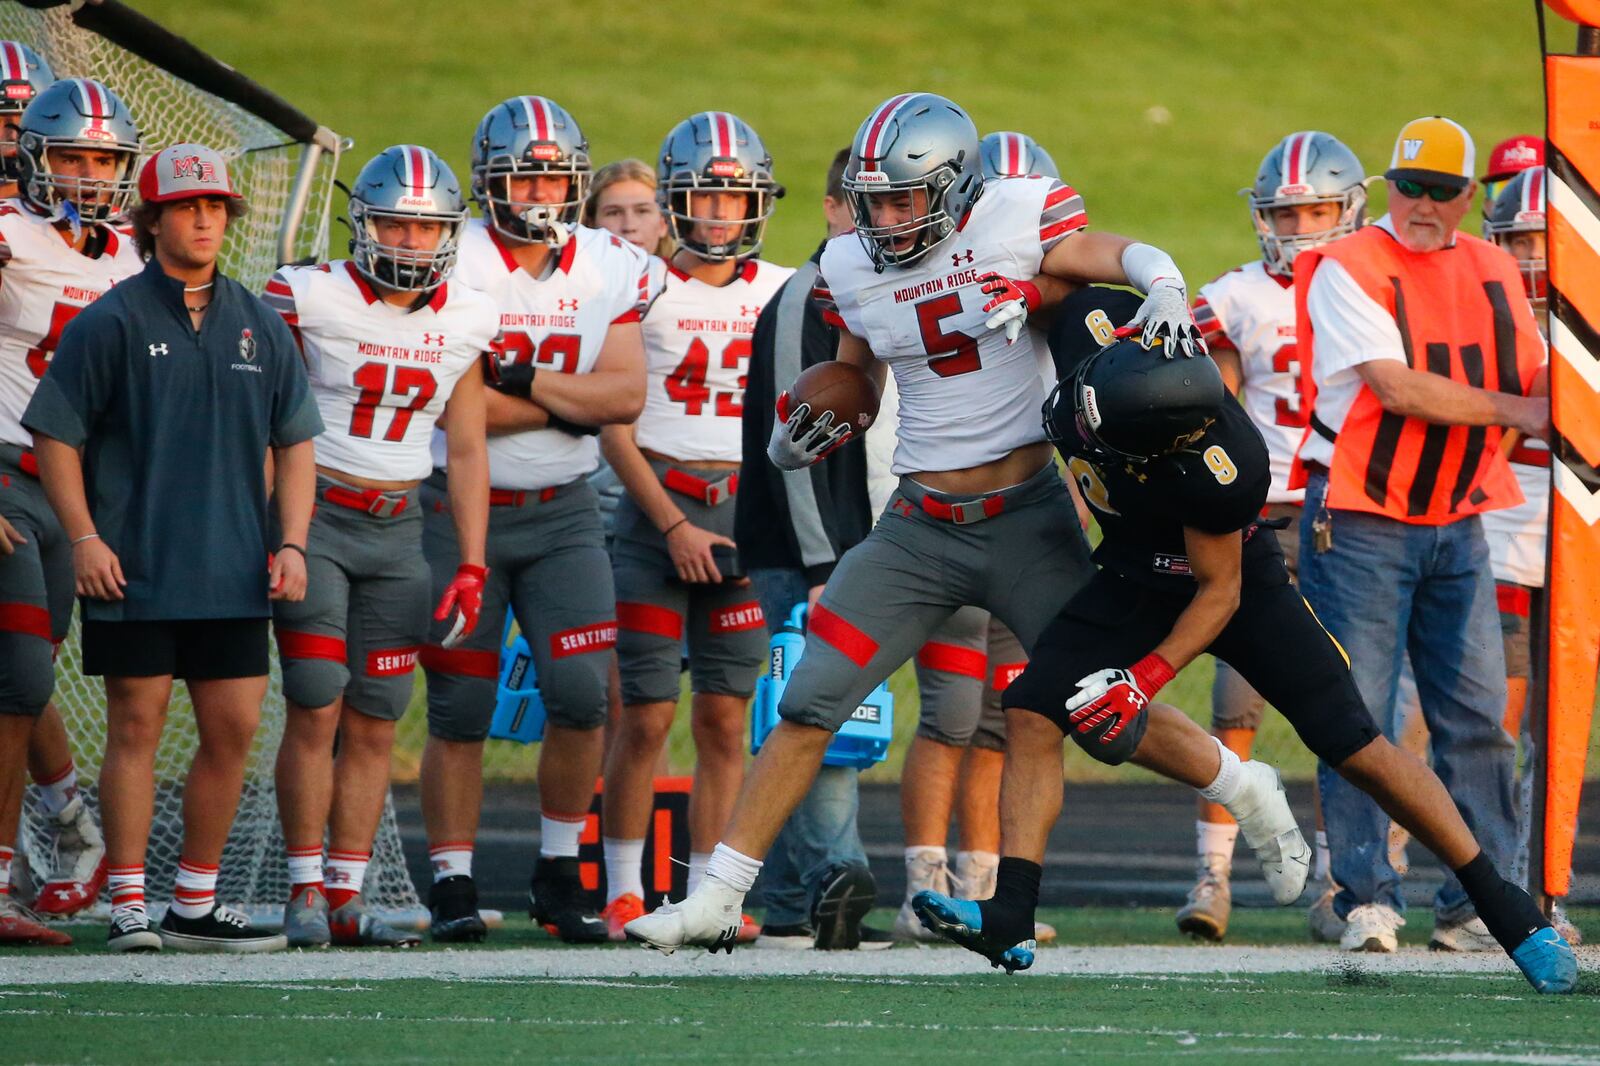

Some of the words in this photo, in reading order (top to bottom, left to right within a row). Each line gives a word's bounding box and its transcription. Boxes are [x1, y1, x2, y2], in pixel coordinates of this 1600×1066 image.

[1403, 140, 1424, 160] W
[401, 197, 432, 207] Riddell
[893, 278, 944, 304] MOUNTAIN
[946, 268, 978, 289] RIDGE
[550, 314, 576, 328] RIDGE
[677, 318, 728, 333] MOUNTAIN
[914, 291, 983, 378] 5
[357, 341, 411, 361] MOUNTAIN
[412, 349, 443, 364] RIDGE
[231, 363, 262, 373] FOOTBALL
[663, 335, 752, 418] 43
[348, 360, 439, 443] 17
[1203, 445, 1238, 486] 9
